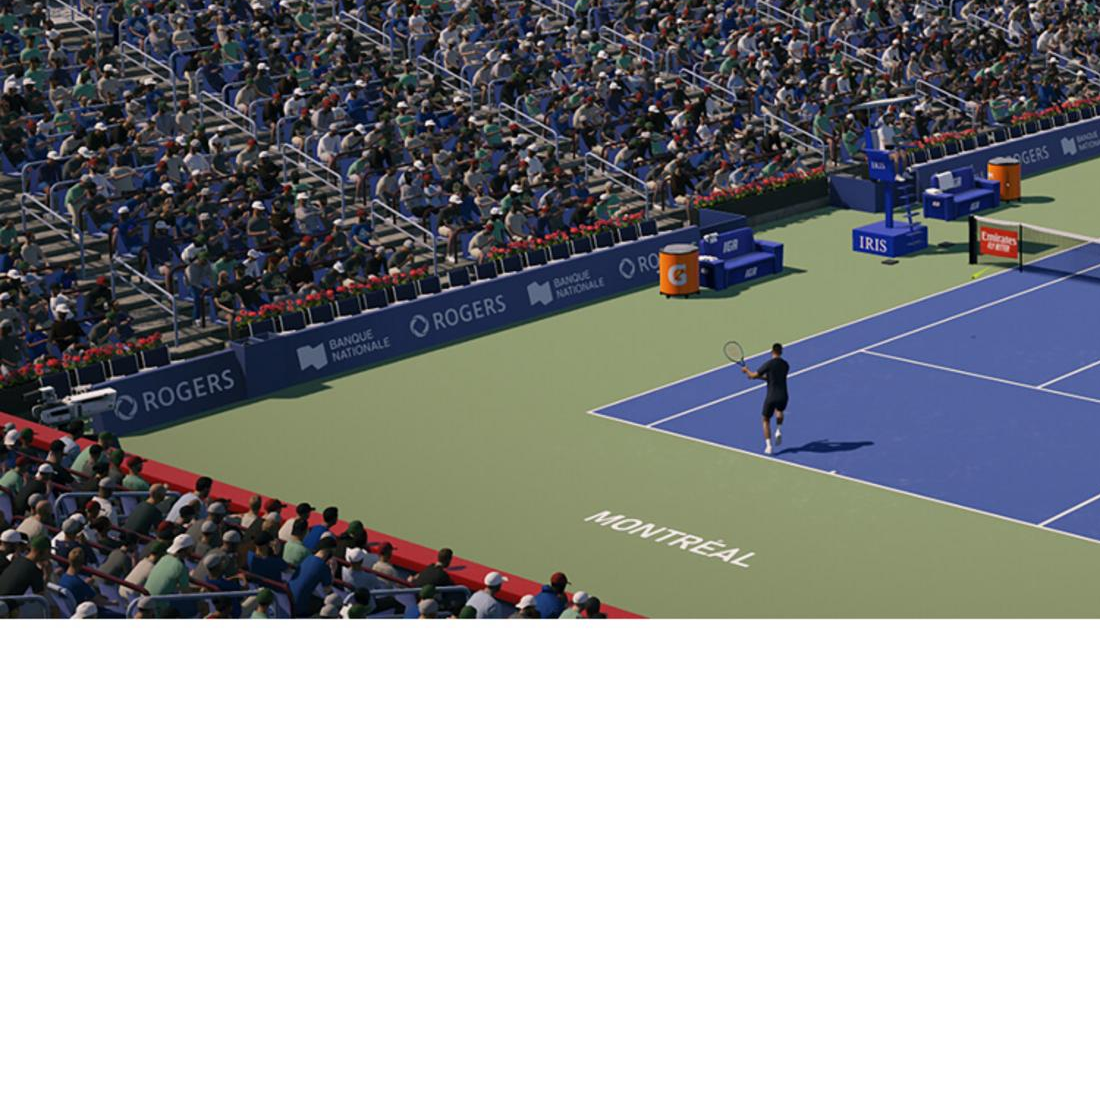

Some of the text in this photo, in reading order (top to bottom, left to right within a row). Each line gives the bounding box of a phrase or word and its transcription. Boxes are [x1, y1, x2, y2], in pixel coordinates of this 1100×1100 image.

[859, 235, 888, 253] IRIS
[981, 231, 1018, 246] Emirates
[552, 269, 591, 289] BANQUE
[667, 264, 688, 287] G
[555, 276, 606, 300] NATIONALE
[432, 294, 507, 332] ROGERS
[329, 328, 374, 351] BANQUE
[332, 336, 391, 363] NATIONALE
[142, 368, 235, 413] ROGERS
[584, 510, 756, 568] MONTRÉAL
